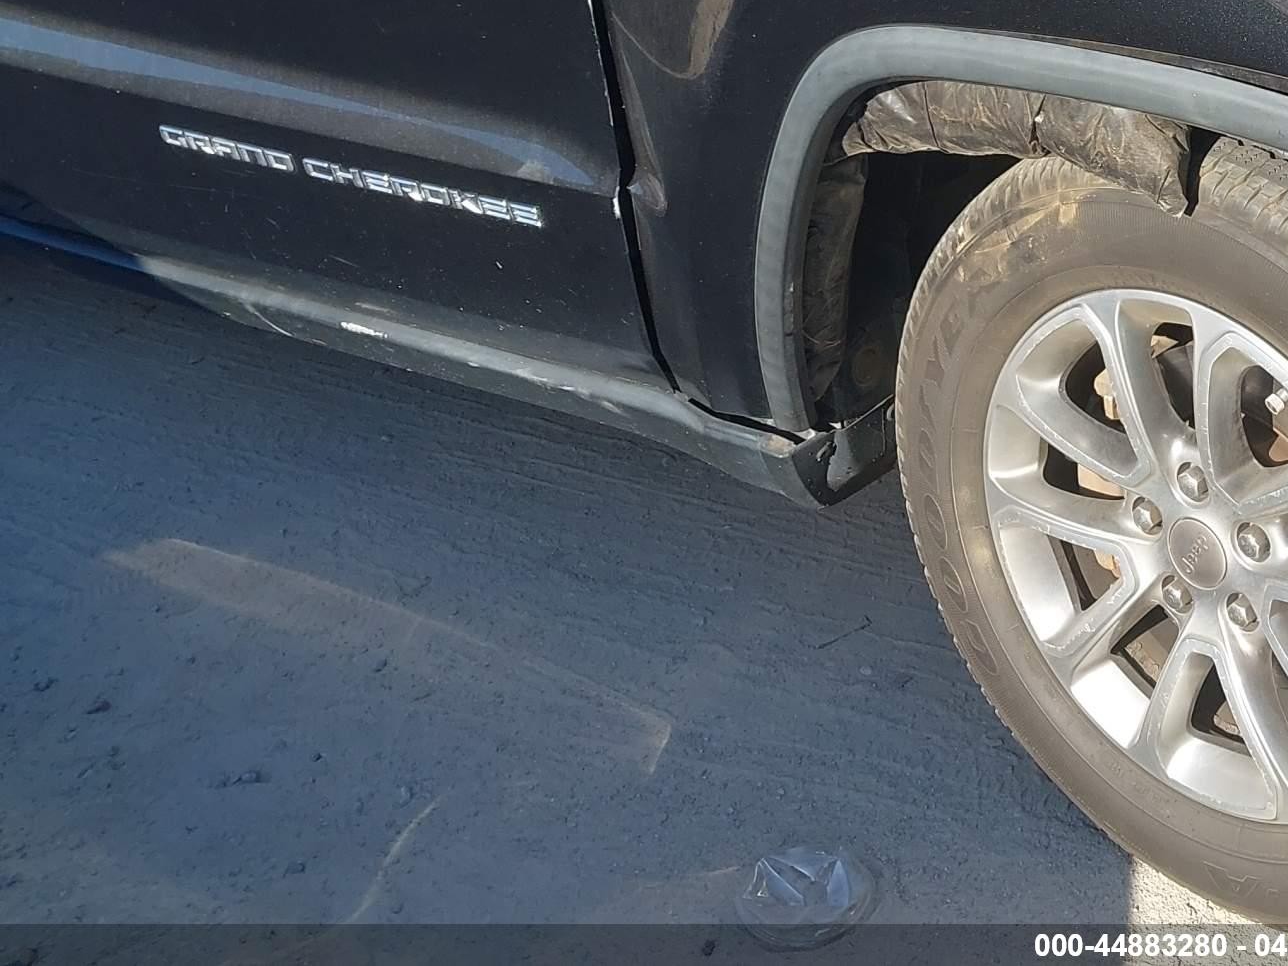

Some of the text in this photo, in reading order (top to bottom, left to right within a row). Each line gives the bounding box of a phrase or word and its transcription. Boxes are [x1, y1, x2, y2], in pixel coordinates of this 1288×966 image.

[158, 124, 543, 228] GRAND CHEROKEE
[1181, 535, 1209, 574] Jeep
